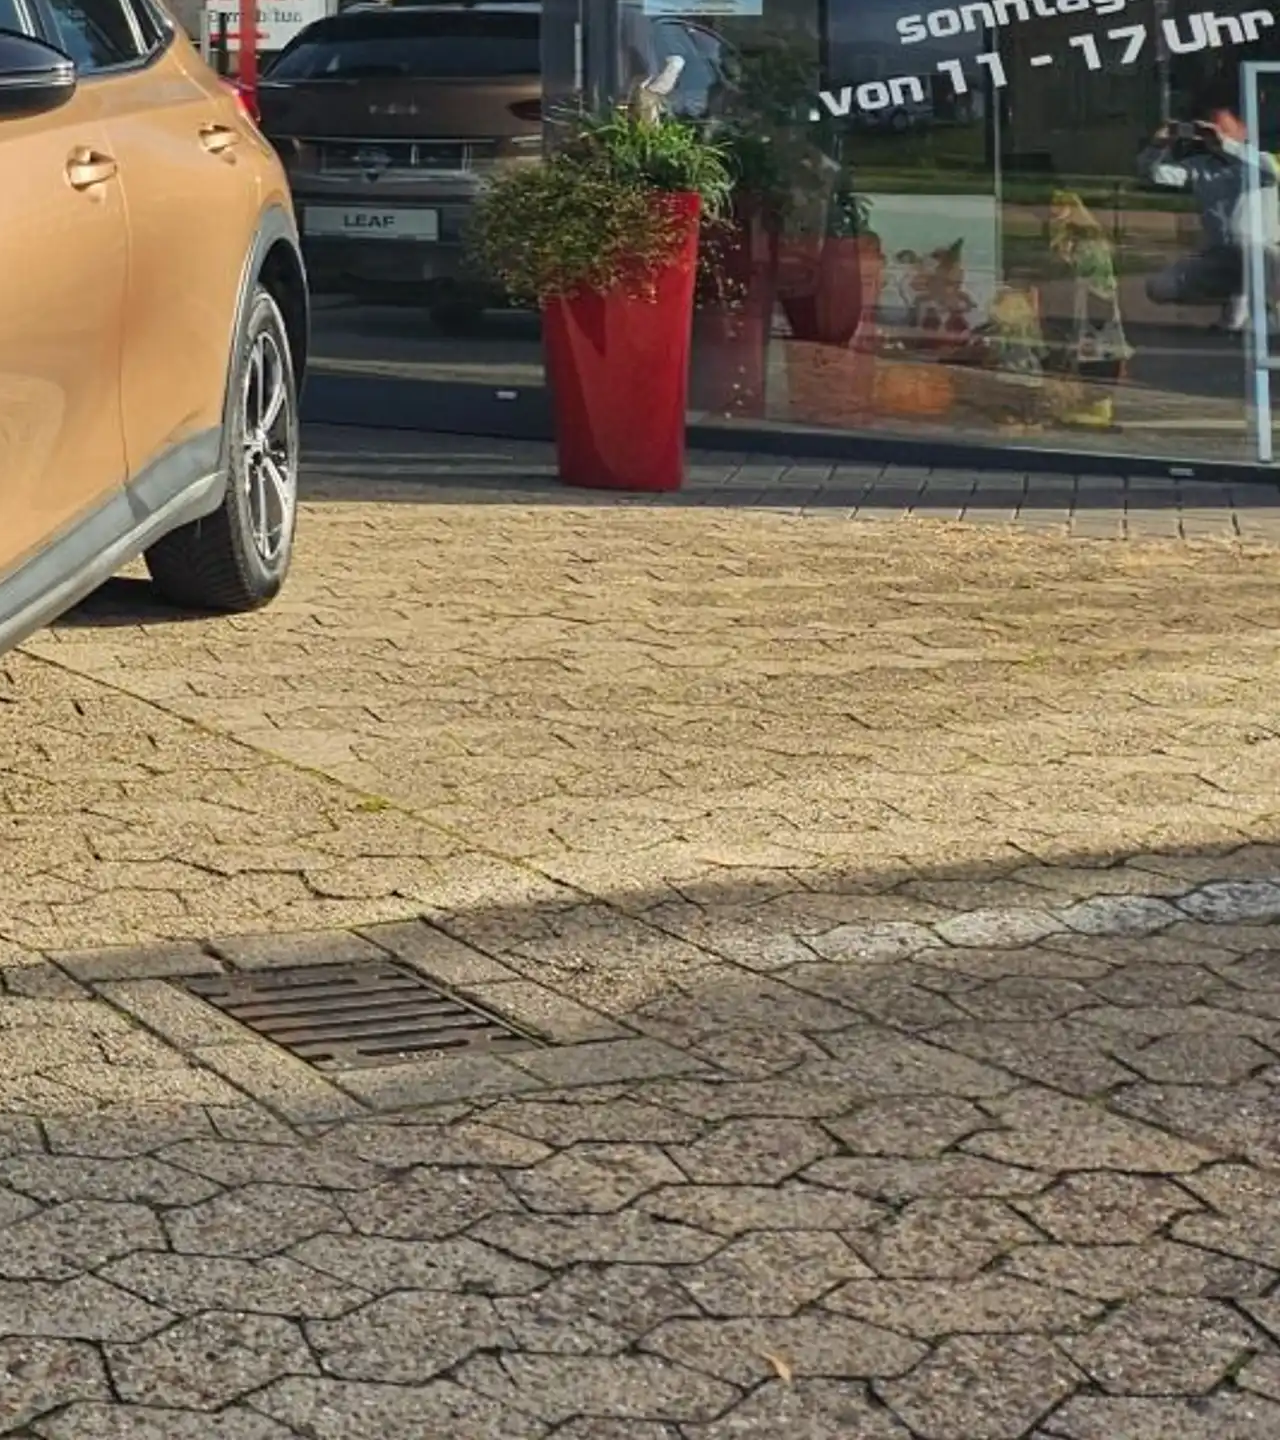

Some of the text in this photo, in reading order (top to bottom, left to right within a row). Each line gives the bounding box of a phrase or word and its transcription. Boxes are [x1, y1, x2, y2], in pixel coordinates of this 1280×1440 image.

[819, 7, 1276, 118] von 11 - 17 Uhr
[343, 213, 396, 228] LEAF
